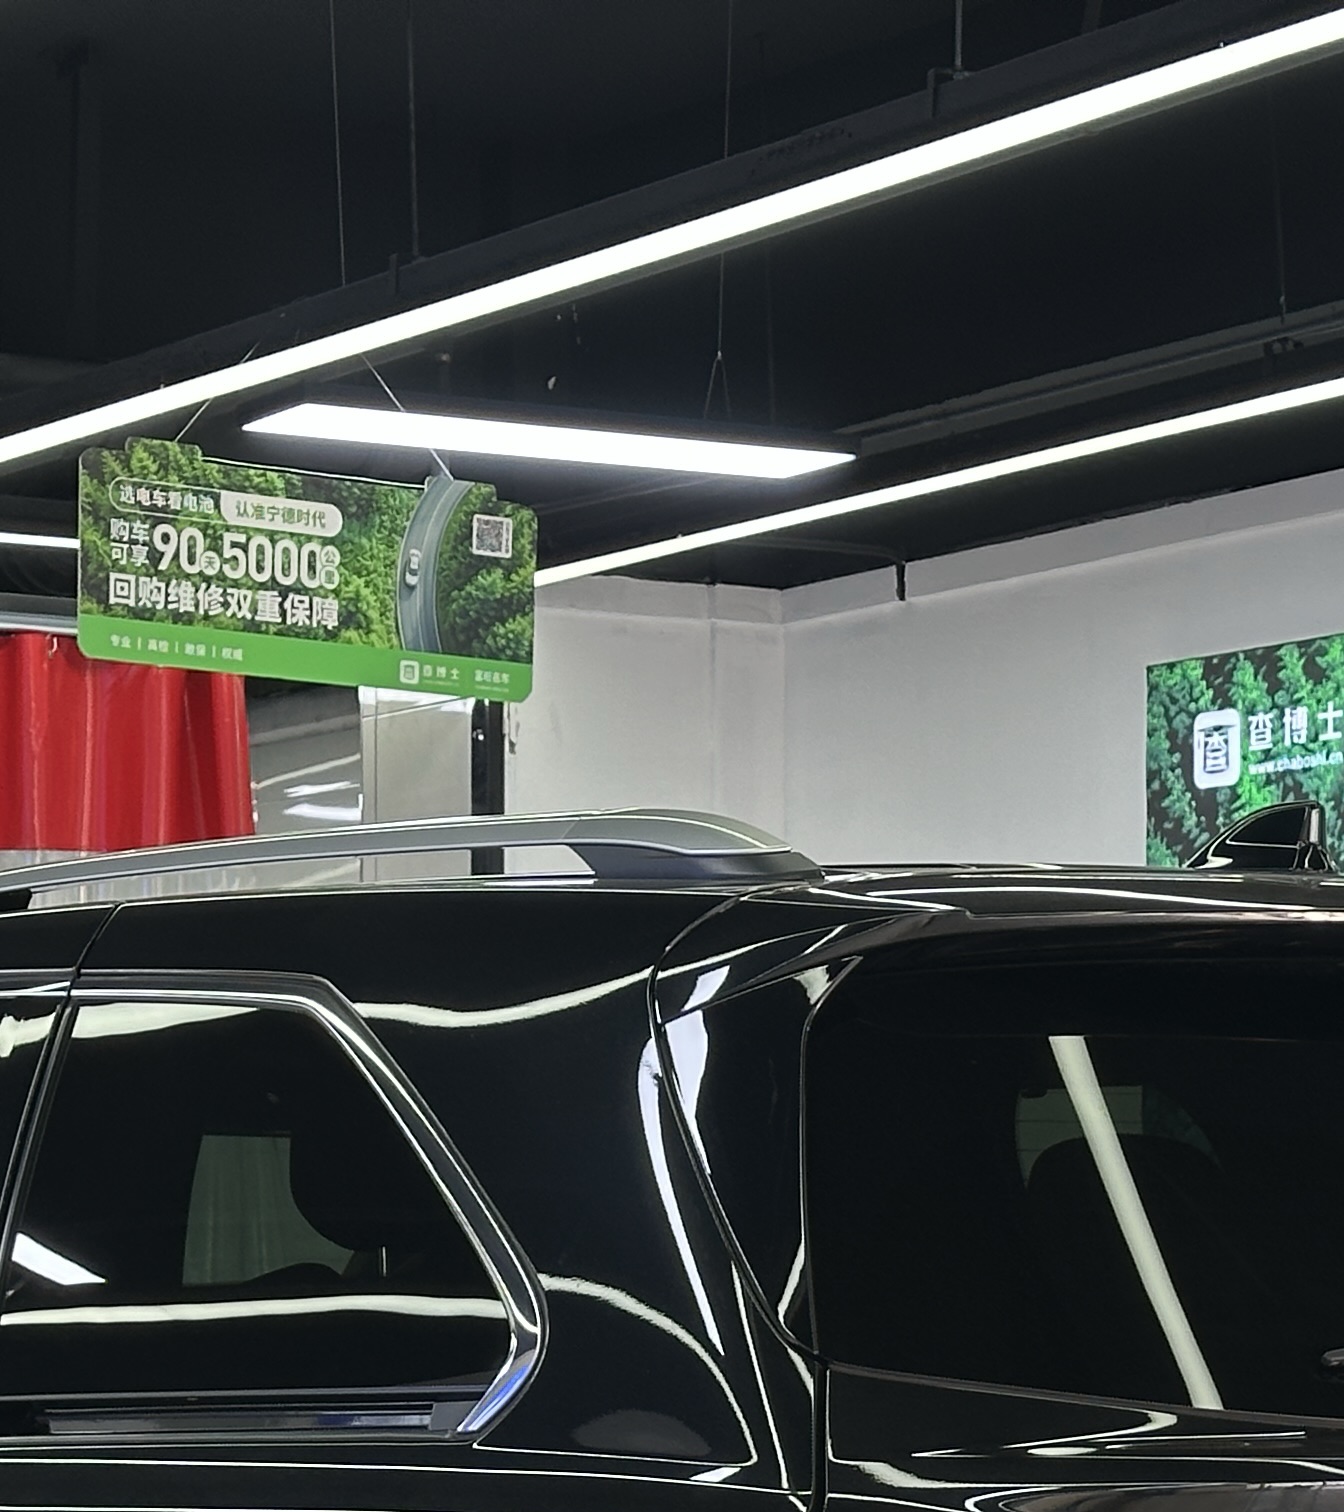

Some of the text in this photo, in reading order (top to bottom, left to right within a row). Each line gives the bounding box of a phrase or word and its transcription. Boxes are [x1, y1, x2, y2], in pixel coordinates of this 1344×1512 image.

[235, 502, 326, 528] 认准宁德时代
[110, 518, 149, 544] 购车
[111, 543, 149, 566] 可享
[109, 572, 339, 629] 回购维修双重保障
[111, 635, 131, 648] 专业
[1248, 701, 1343, 750] 查博士
